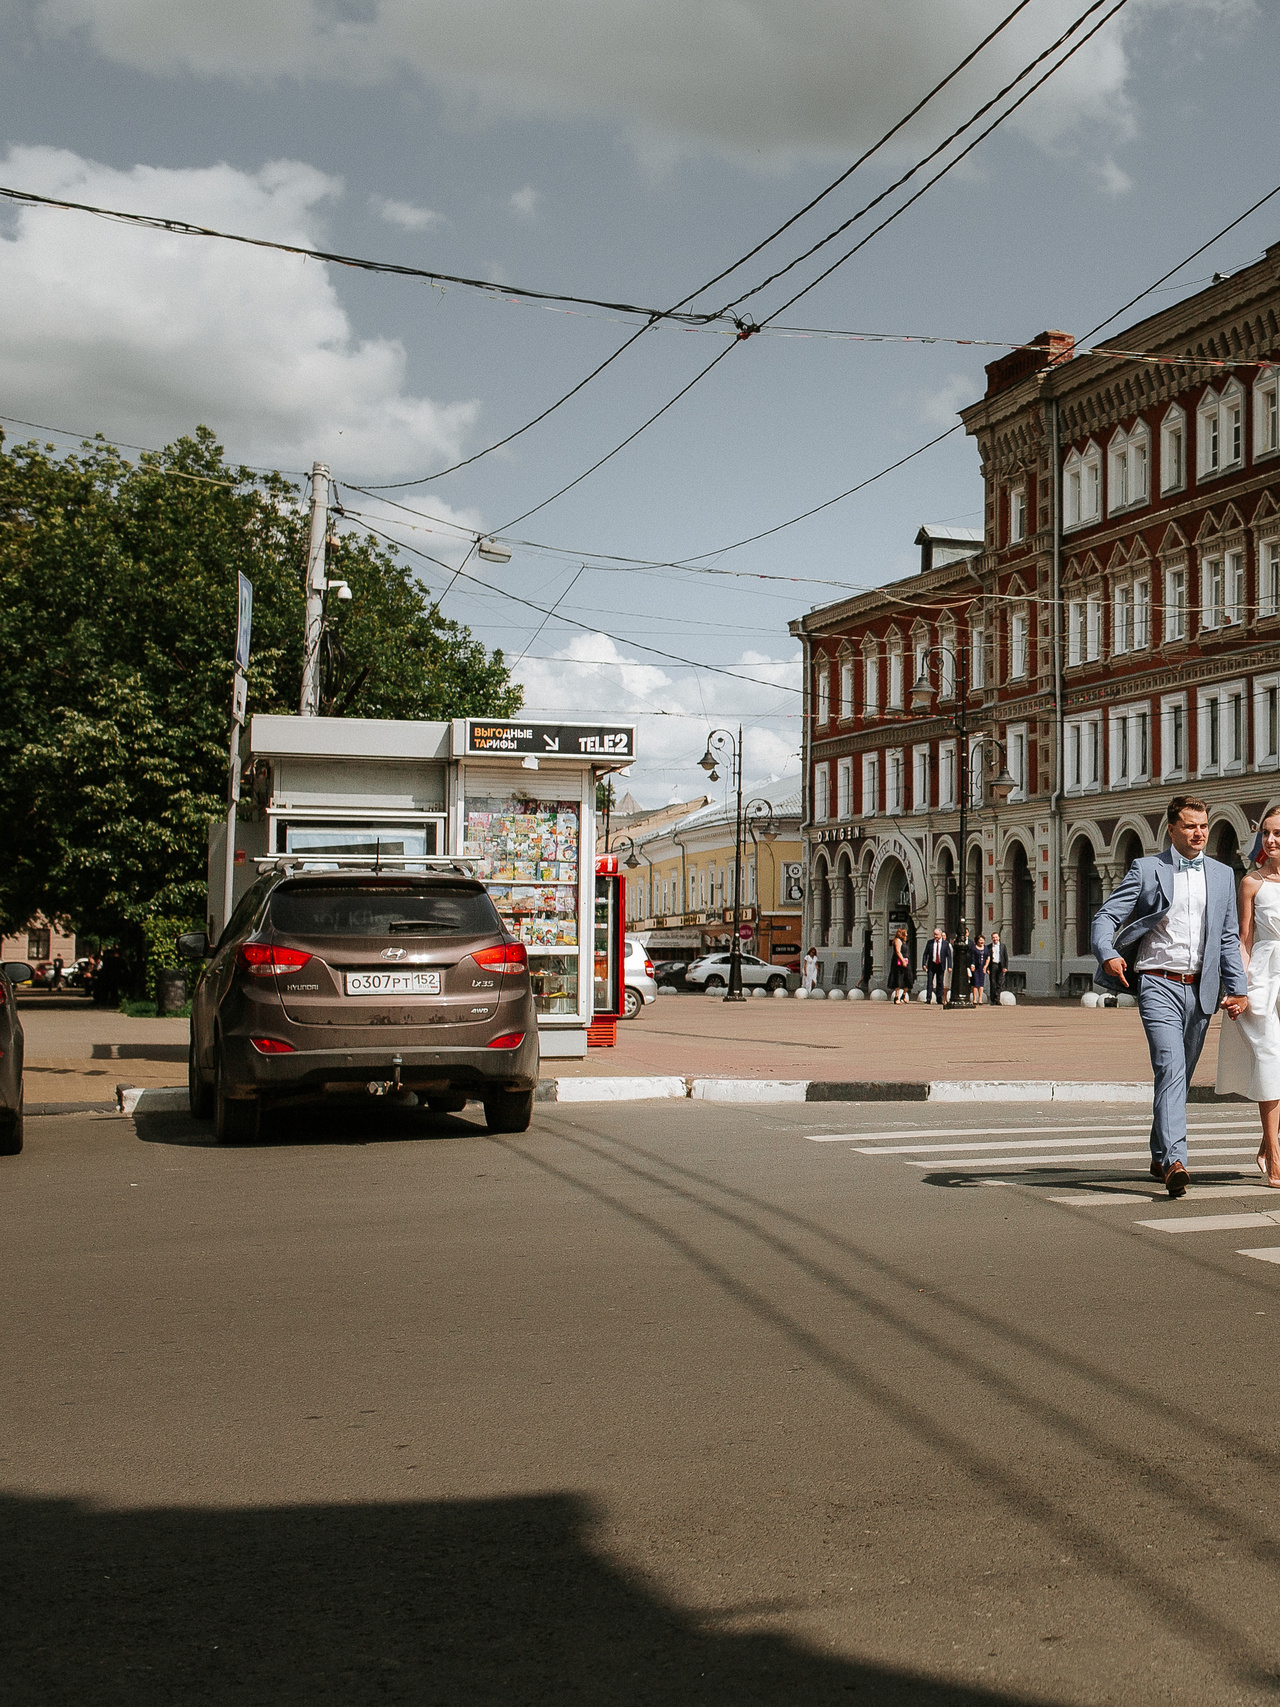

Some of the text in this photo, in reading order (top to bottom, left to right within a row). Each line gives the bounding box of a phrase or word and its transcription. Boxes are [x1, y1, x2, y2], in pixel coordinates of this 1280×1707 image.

[474, 727, 533, 739] ВЫГОДНЫЕ
[474, 739, 517, 750] ТАРИФЫ
[578, 733, 628, 754] TELE2
[817, 826, 861, 842] OXYGEN
[352, 974, 436, 989] О307РТ 152
